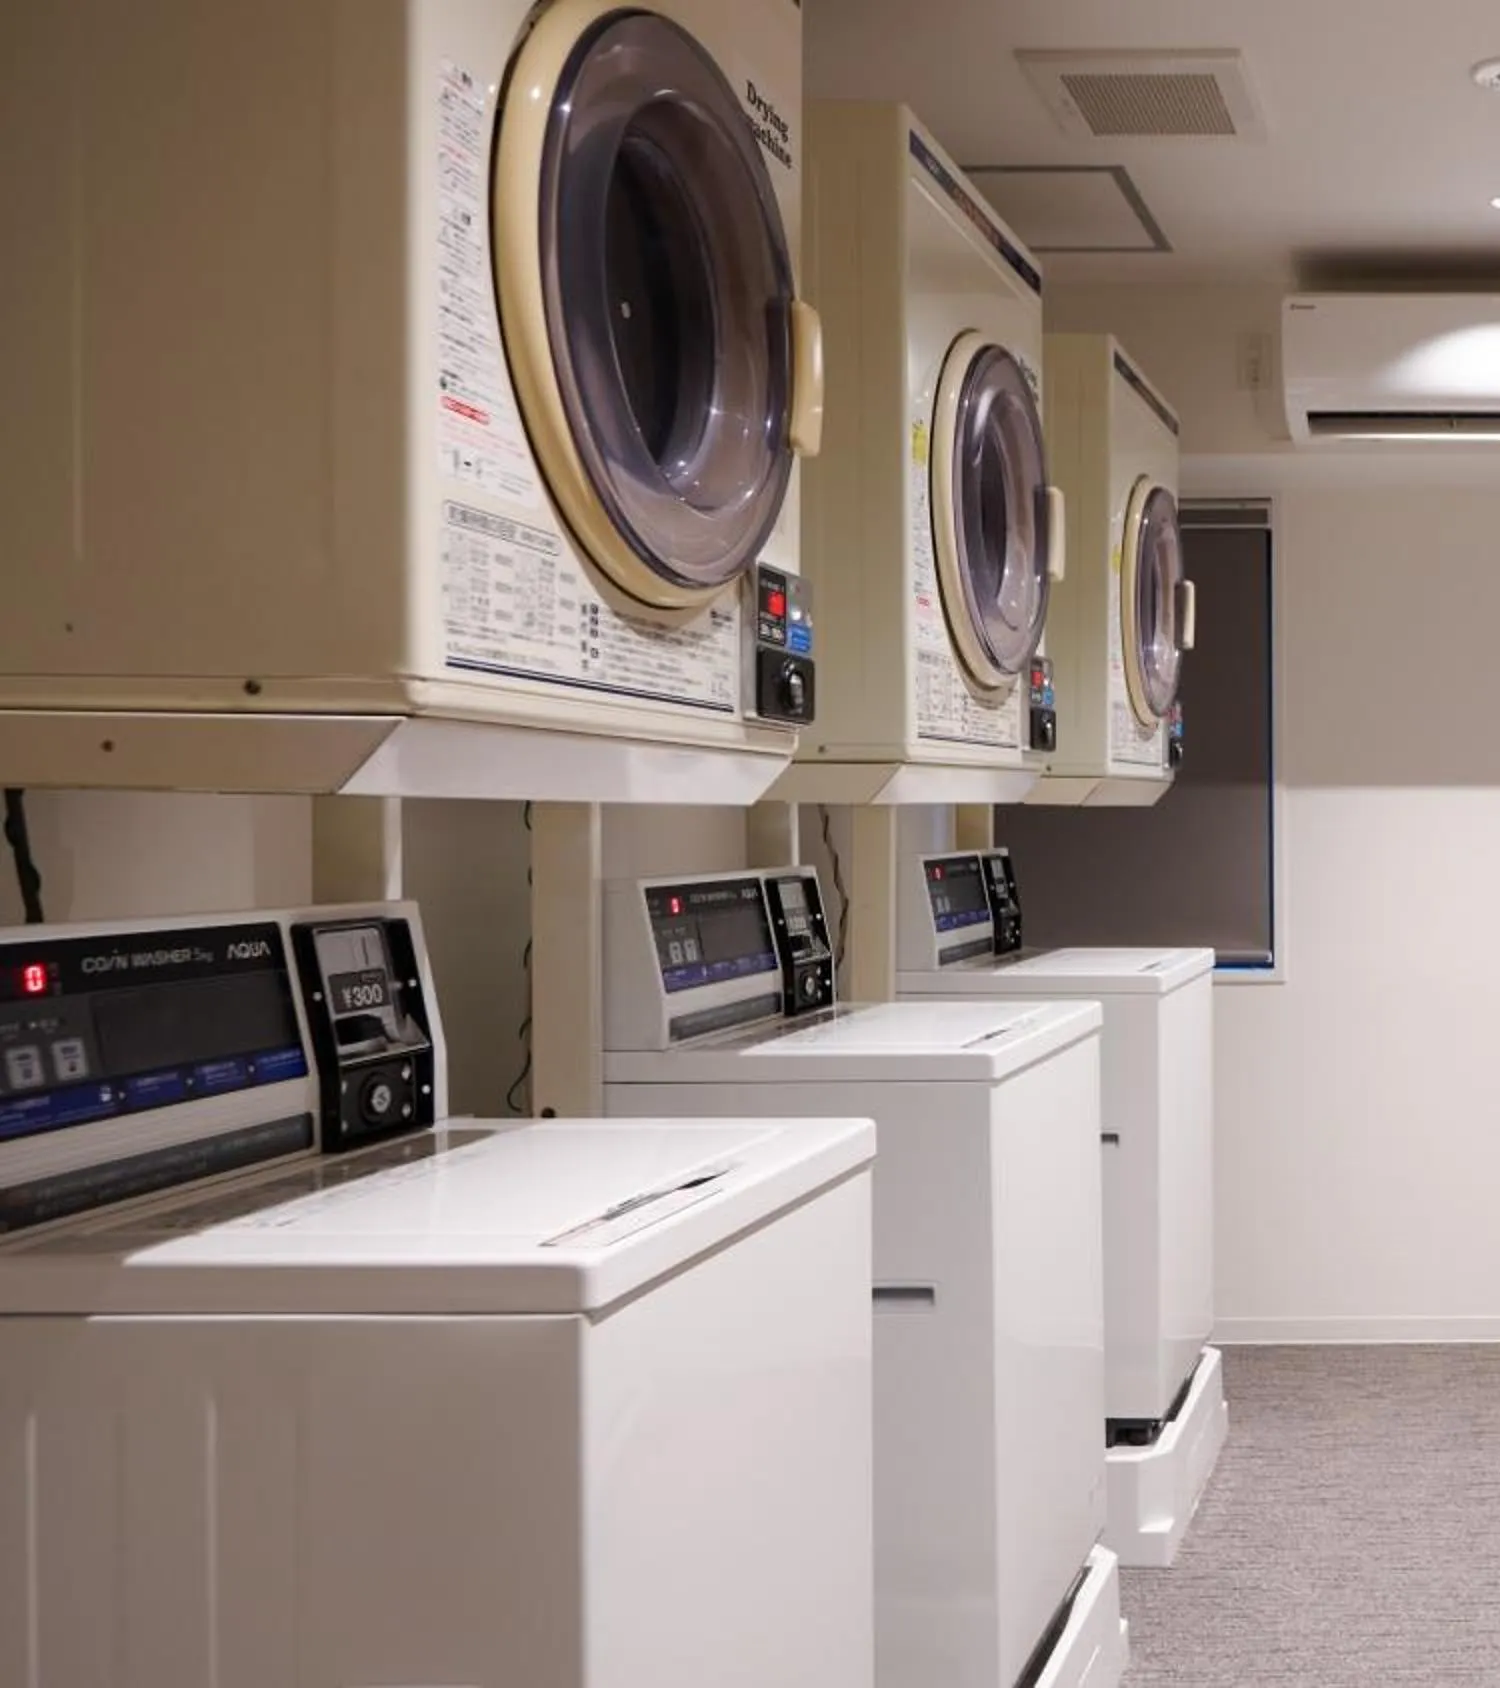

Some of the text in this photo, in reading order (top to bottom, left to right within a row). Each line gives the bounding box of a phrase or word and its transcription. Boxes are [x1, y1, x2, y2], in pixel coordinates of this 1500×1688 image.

[746, 79, 789, 143] Drying
[752, 123, 792, 169] achine
[131, 948, 192, 967] WASHER
[225, 940, 272, 960] AQUA
[342, 983, 383, 1009] ¥300
